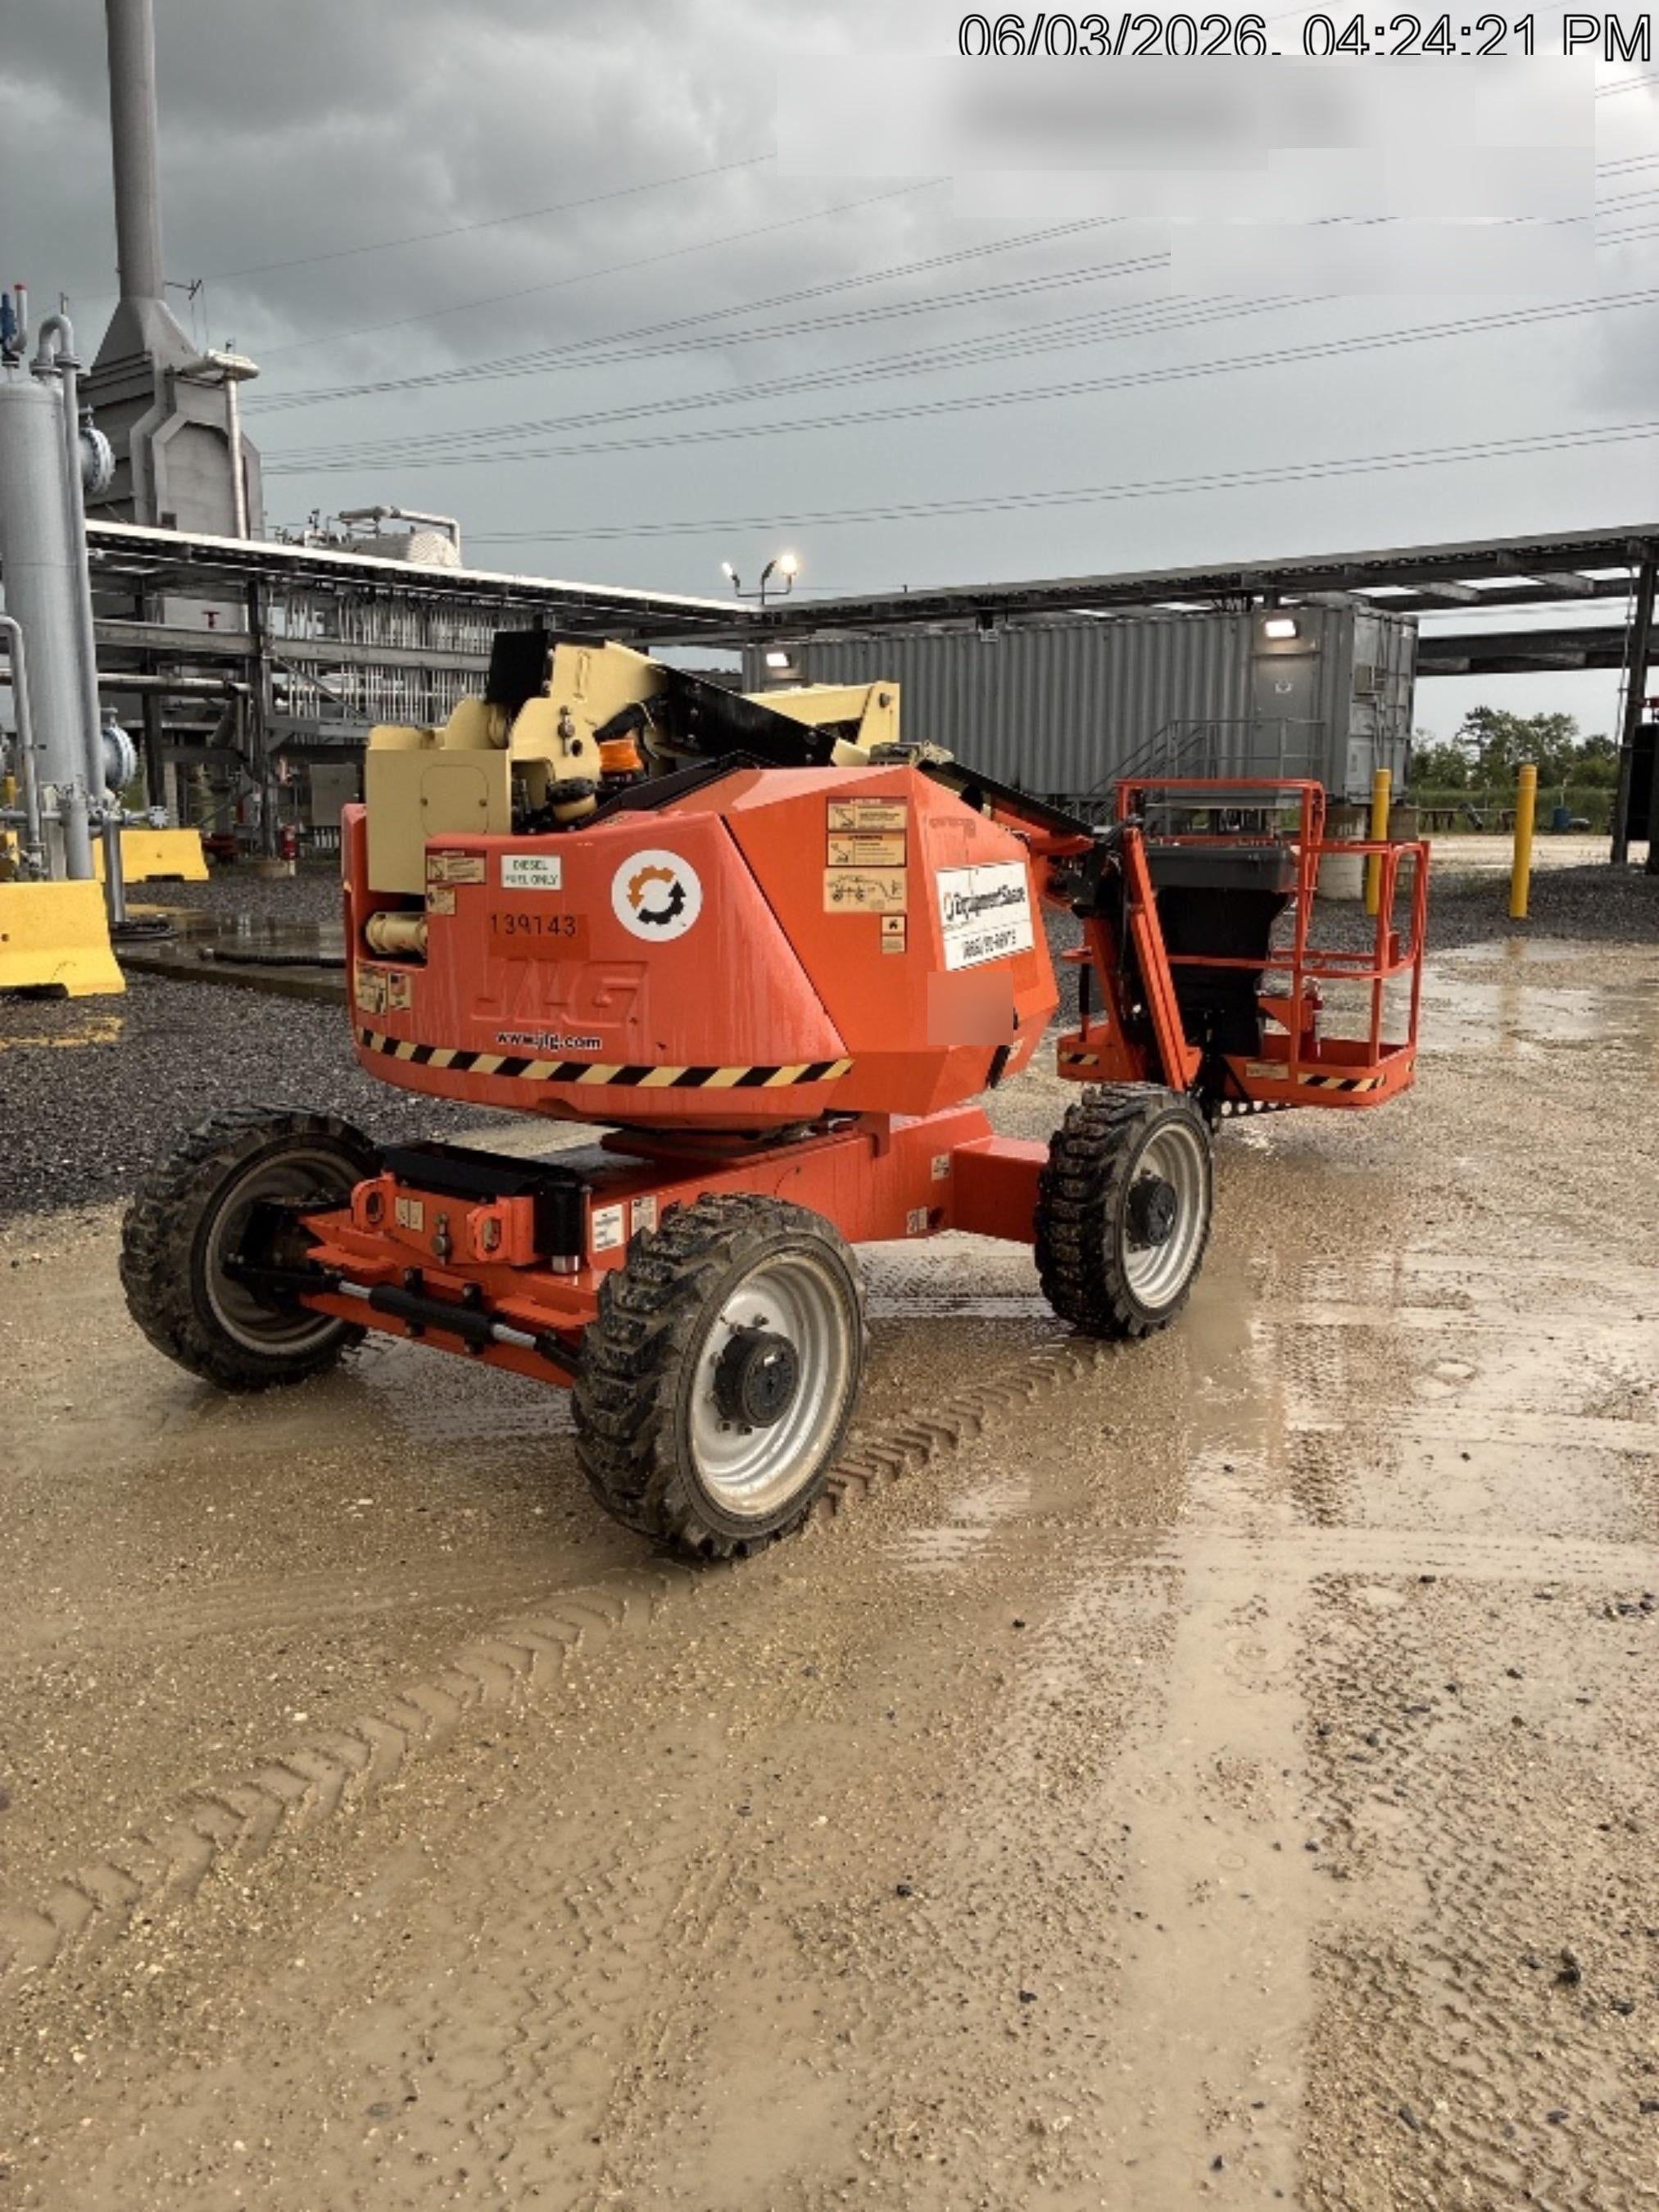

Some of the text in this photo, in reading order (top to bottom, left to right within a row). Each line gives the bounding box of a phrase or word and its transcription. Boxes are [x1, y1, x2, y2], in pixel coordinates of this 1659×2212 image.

[513, 859, 549, 871] DIESEL
[531, 874, 558, 886] ONLY
[491, 913, 577, 937] 139143
[470, 957, 648, 1028] JLG
[496, 1031, 602, 1051] www.jlg.com
